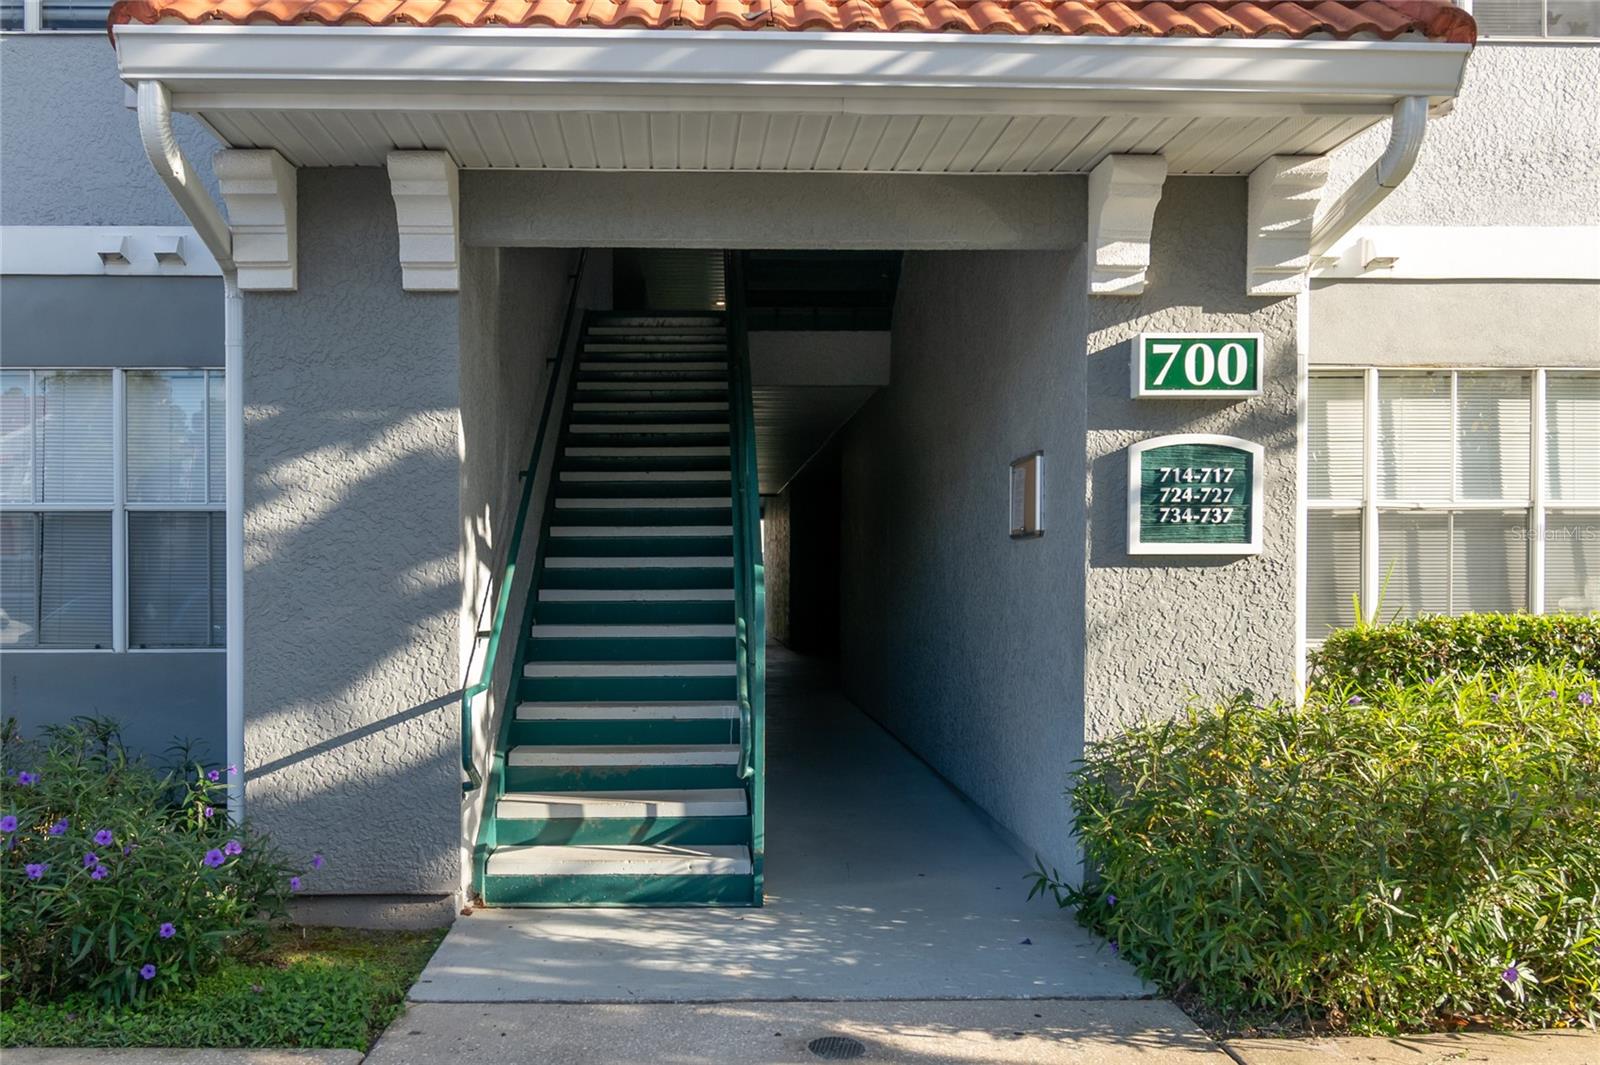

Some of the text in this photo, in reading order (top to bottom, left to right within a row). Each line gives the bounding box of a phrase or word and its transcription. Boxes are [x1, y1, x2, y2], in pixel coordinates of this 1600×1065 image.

[1152, 343, 1248, 386] 700
[1160, 467, 1235, 484] 714-717
[1160, 487, 1235, 503] 724-727
[1160, 507, 1235, 524] 734-737
